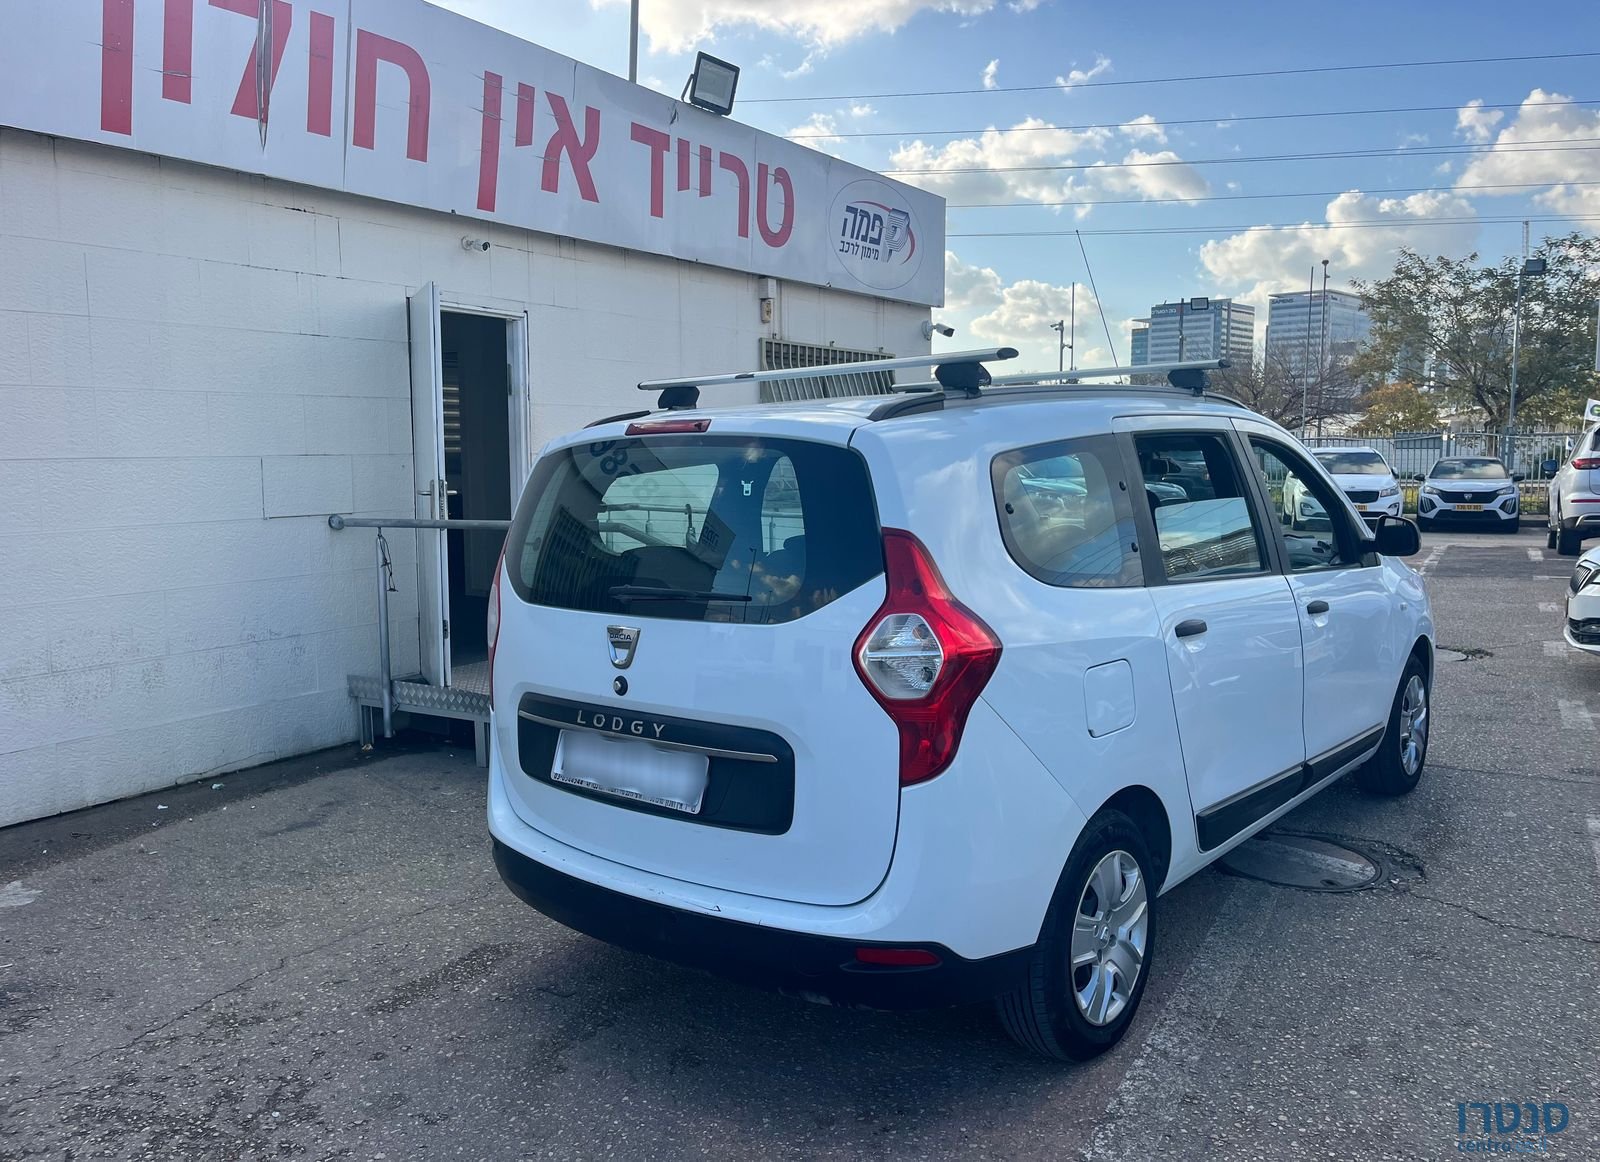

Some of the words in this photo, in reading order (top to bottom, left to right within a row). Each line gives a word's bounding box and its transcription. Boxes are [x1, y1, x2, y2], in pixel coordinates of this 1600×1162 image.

[100, 0, 431, 163] חולון
[476, 69, 600, 213] אין
[630, 121, 794, 248] טרייד
[841, 205, 884, 246] פמה
[839, 240, 860, 256] לרכב
[860, 245, 880, 261] מימון
[609, 632, 632, 641] DACIA
[576, 709, 667, 738] LODGY
